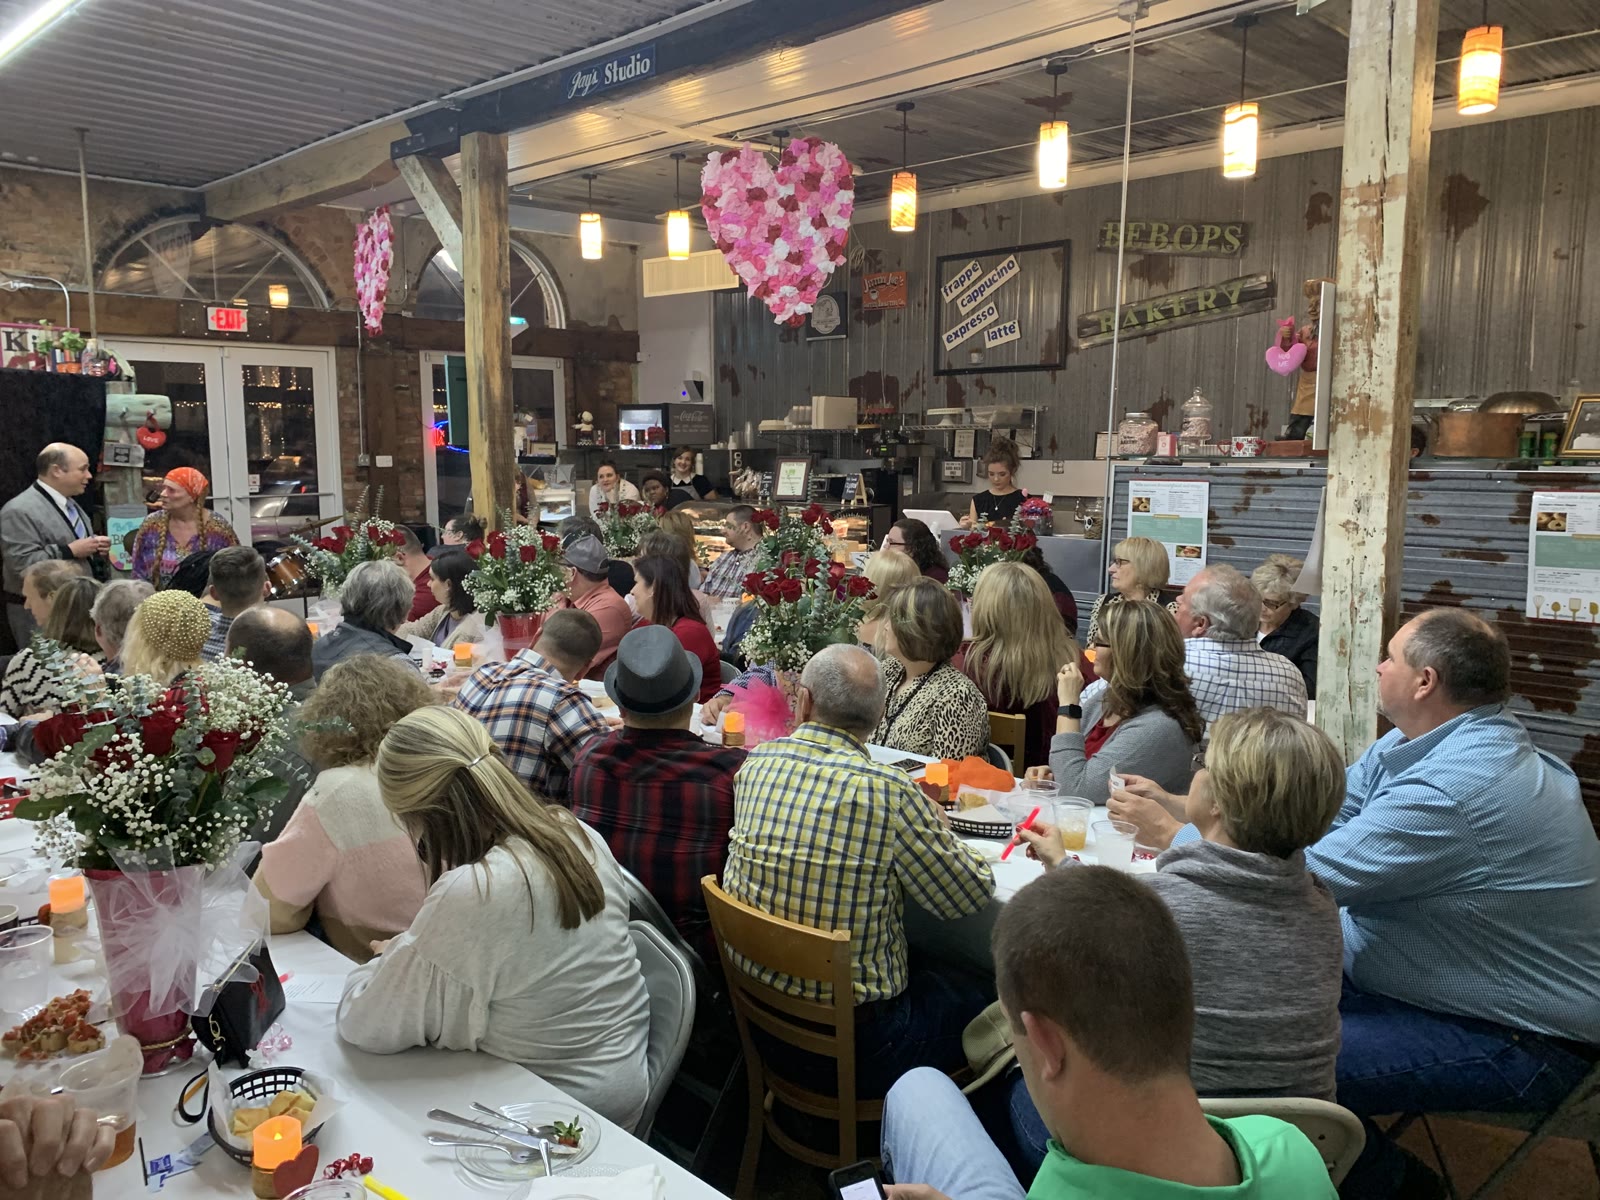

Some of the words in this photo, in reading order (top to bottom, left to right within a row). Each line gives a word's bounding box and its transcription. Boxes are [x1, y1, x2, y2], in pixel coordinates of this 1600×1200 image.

[567, 69, 599, 99] Jay's
[604, 53, 651, 85] Studio
[1104, 221, 1244, 254] BEBOPS
[960, 259, 1016, 308] cappucino
[216, 308, 242, 330] EXIT
[945, 305, 995, 344] expresso
[143, 435, 160, 444] LOVE
